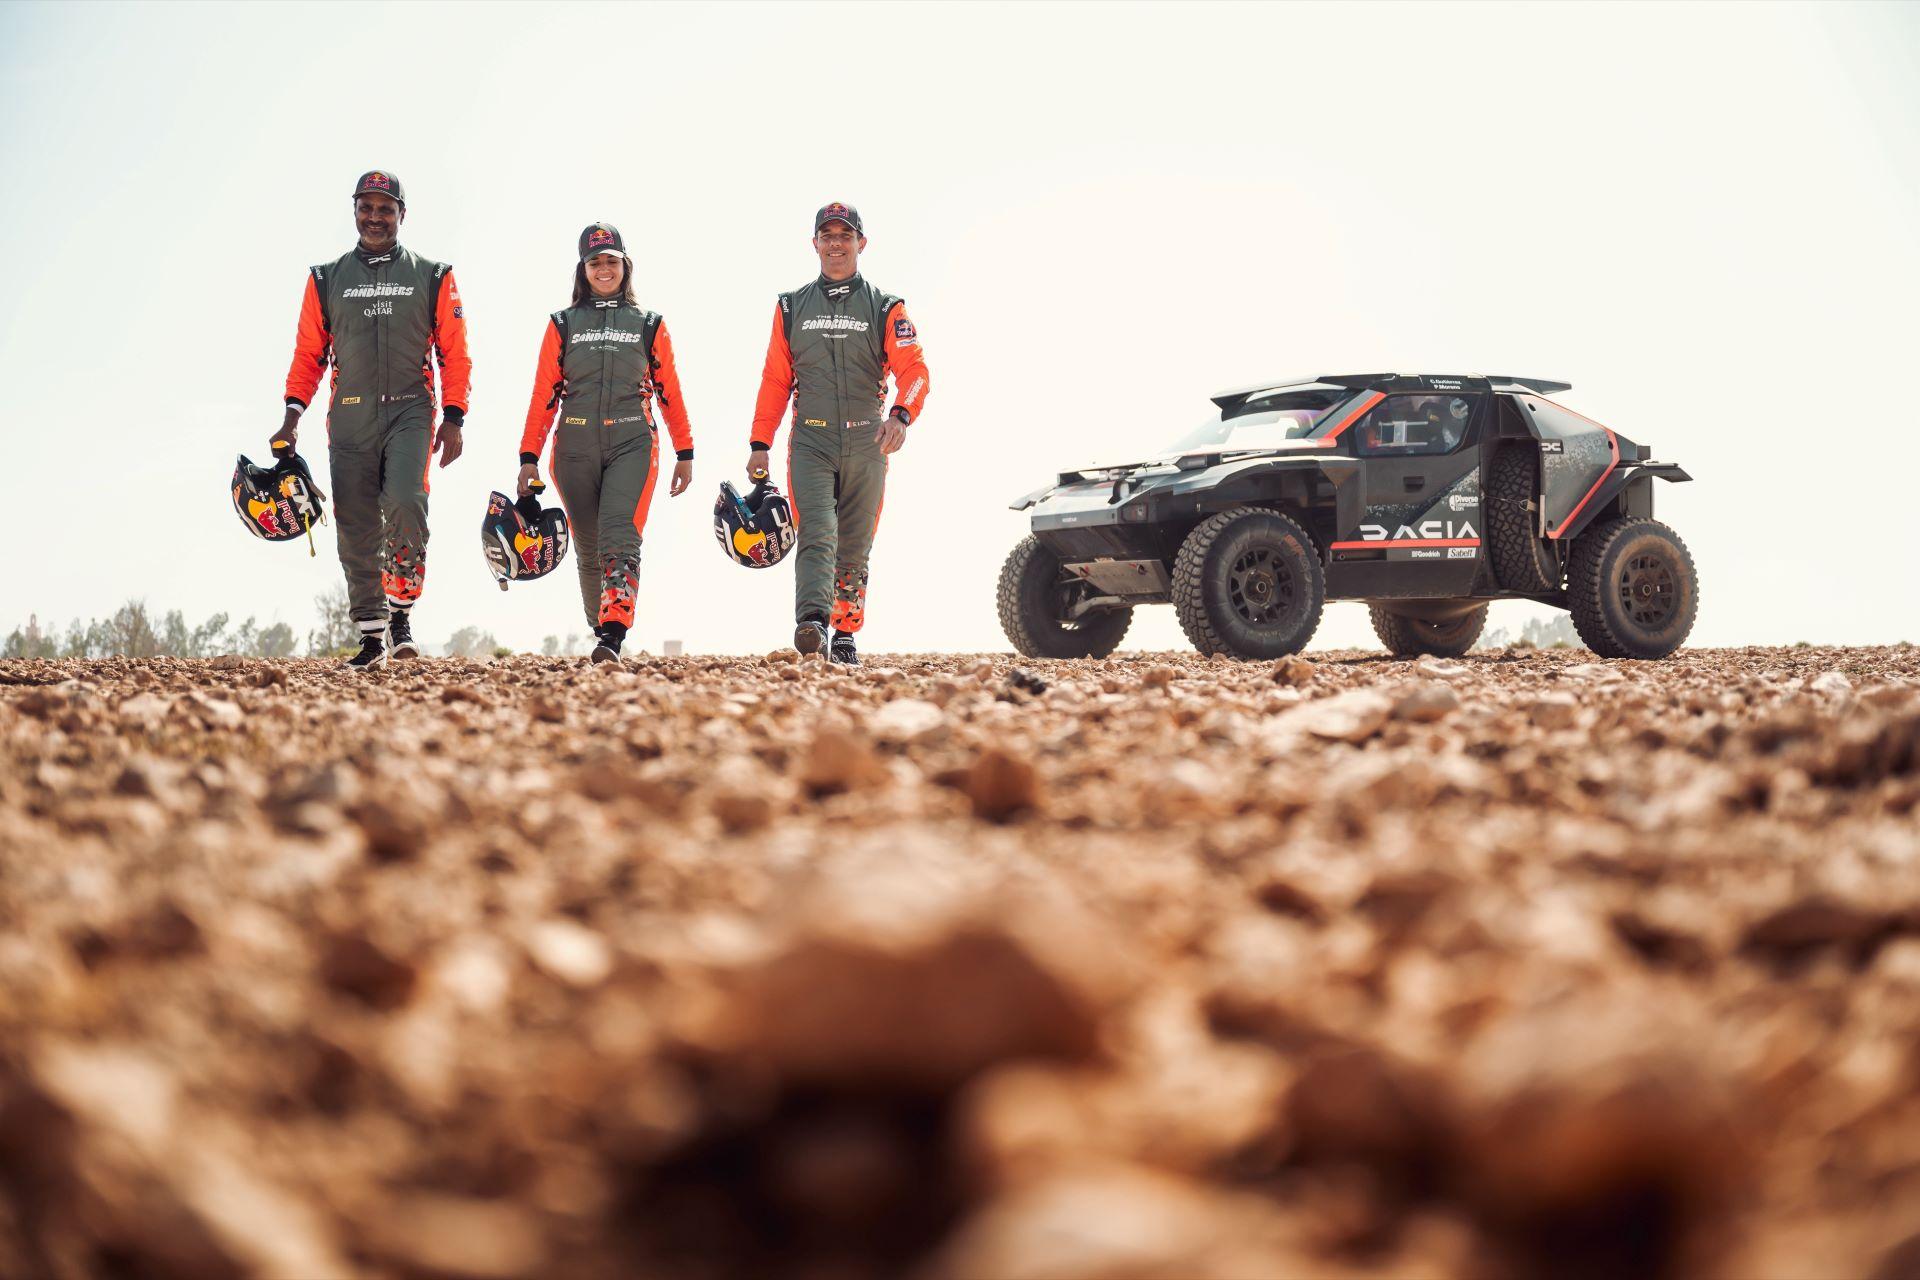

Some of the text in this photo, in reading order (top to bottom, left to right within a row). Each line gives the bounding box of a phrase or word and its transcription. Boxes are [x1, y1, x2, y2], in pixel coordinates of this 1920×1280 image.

[342, 285, 415, 298] SANDRIDERS
[373, 300, 393, 309] visit
[363, 307, 393, 318] QATAR
[801, 318, 869, 332] SANDRIDERS
[571, 330, 641, 344] SANDRIDERS
[1359, 520, 1480, 541] DACIA
[1450, 548, 1473, 558] Sabelt
